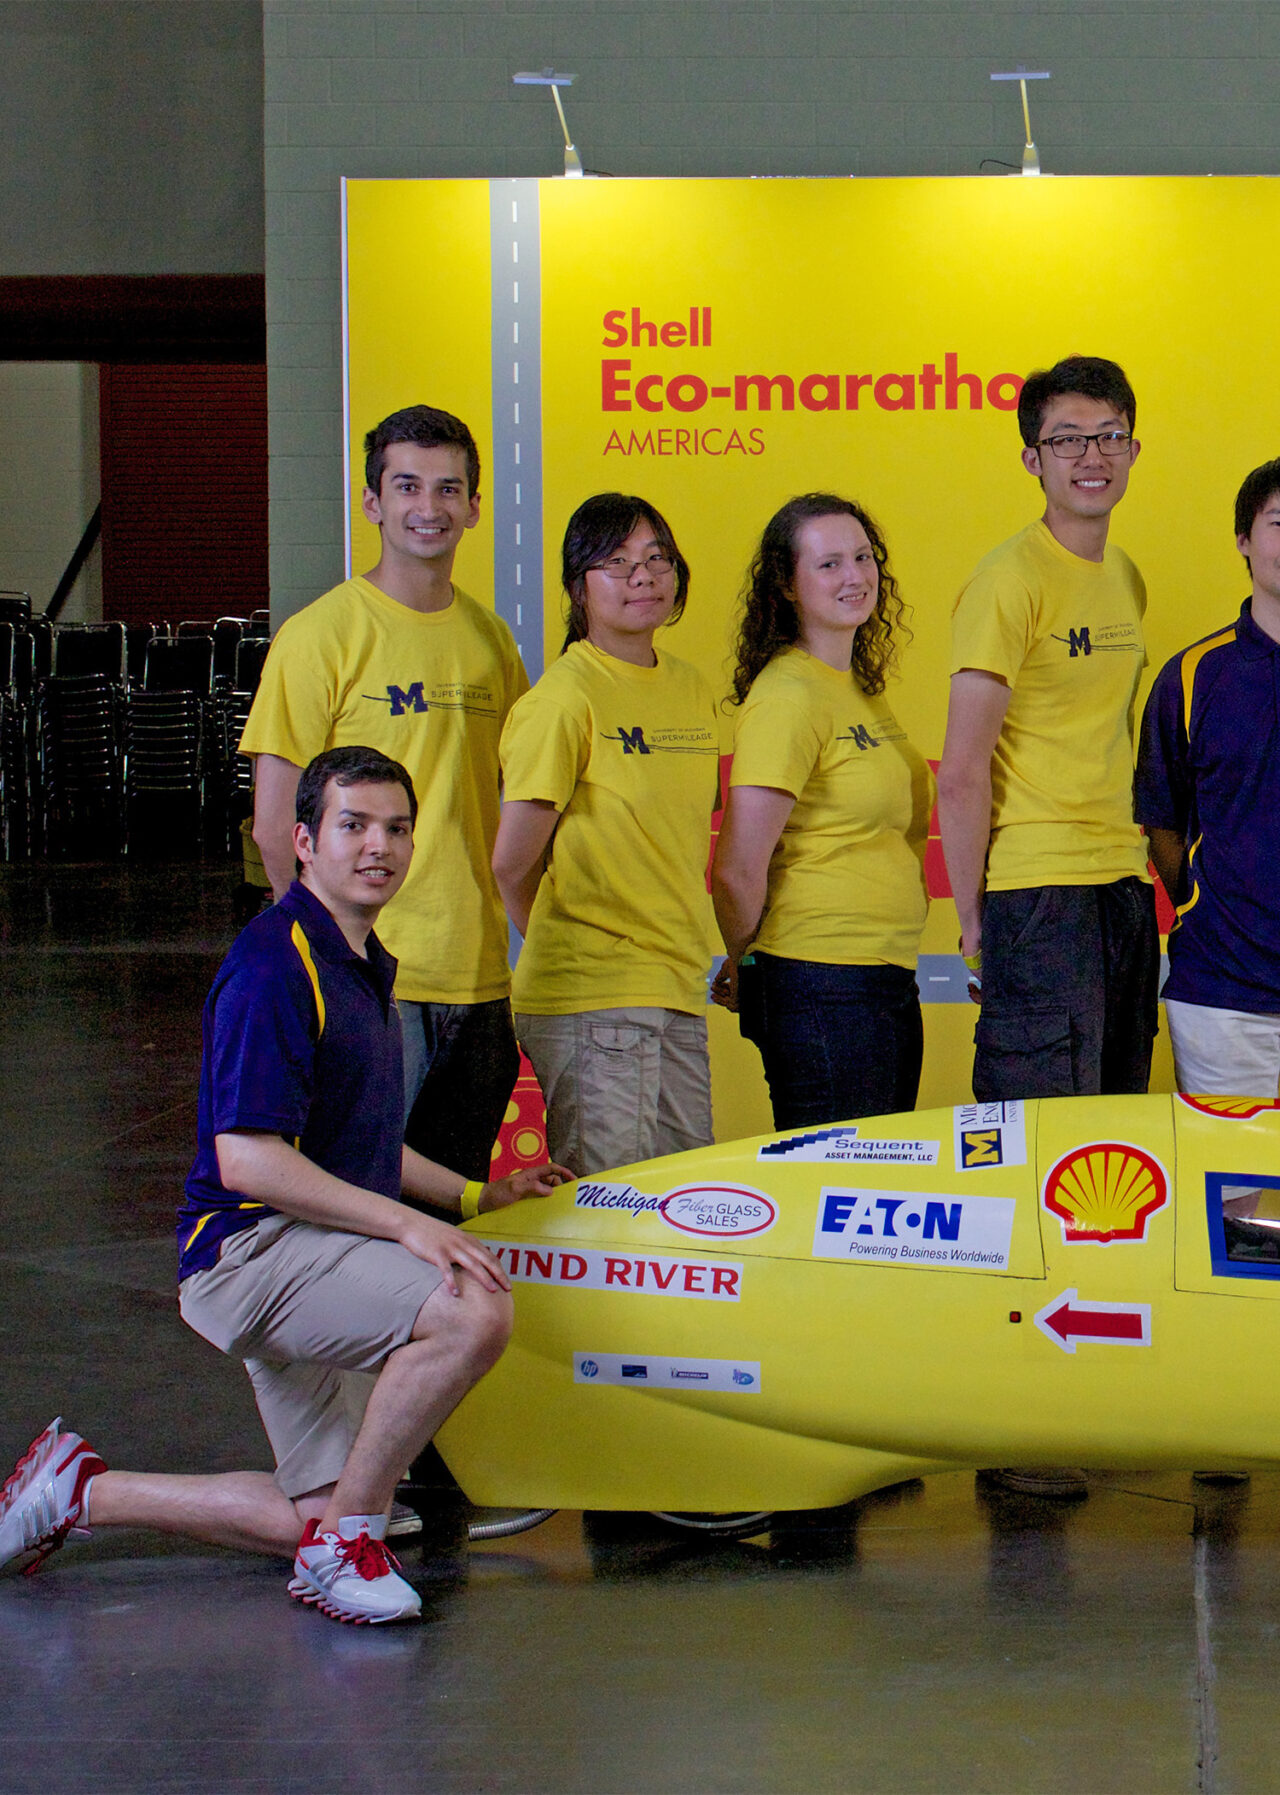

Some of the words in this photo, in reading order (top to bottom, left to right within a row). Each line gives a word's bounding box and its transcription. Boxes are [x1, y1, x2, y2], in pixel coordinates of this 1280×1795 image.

[602, 307, 712, 348] Shell
[601, 352, 1023, 412] Eco-maratho
[604, 429, 765, 456] AMERICAS
[1068, 627, 1092, 657] M
[386, 681, 429, 717] M
[617, 727, 651, 754] M
[825, 1152, 851, 1160] ASSET
[853, 1152, 915, 1162] MANAGEMENT,
[917, 1154, 933, 1162] LLC
[835, 1139, 924, 1152] Sequent
[576, 1184, 670, 1218] Michigan
[677, 1198, 714, 1214] Fiber
[716, 1201, 762, 1217] GLASS
[696, 1213, 739, 1228] SALES
[821, 1195, 963, 1241] EATON
[849, 1242, 898, 1259] Powering
[900, 1245, 948, 1260] Business
[950, 1249, 1005, 1264] Worldwide
[604, 1257, 740, 1296] RIVER
